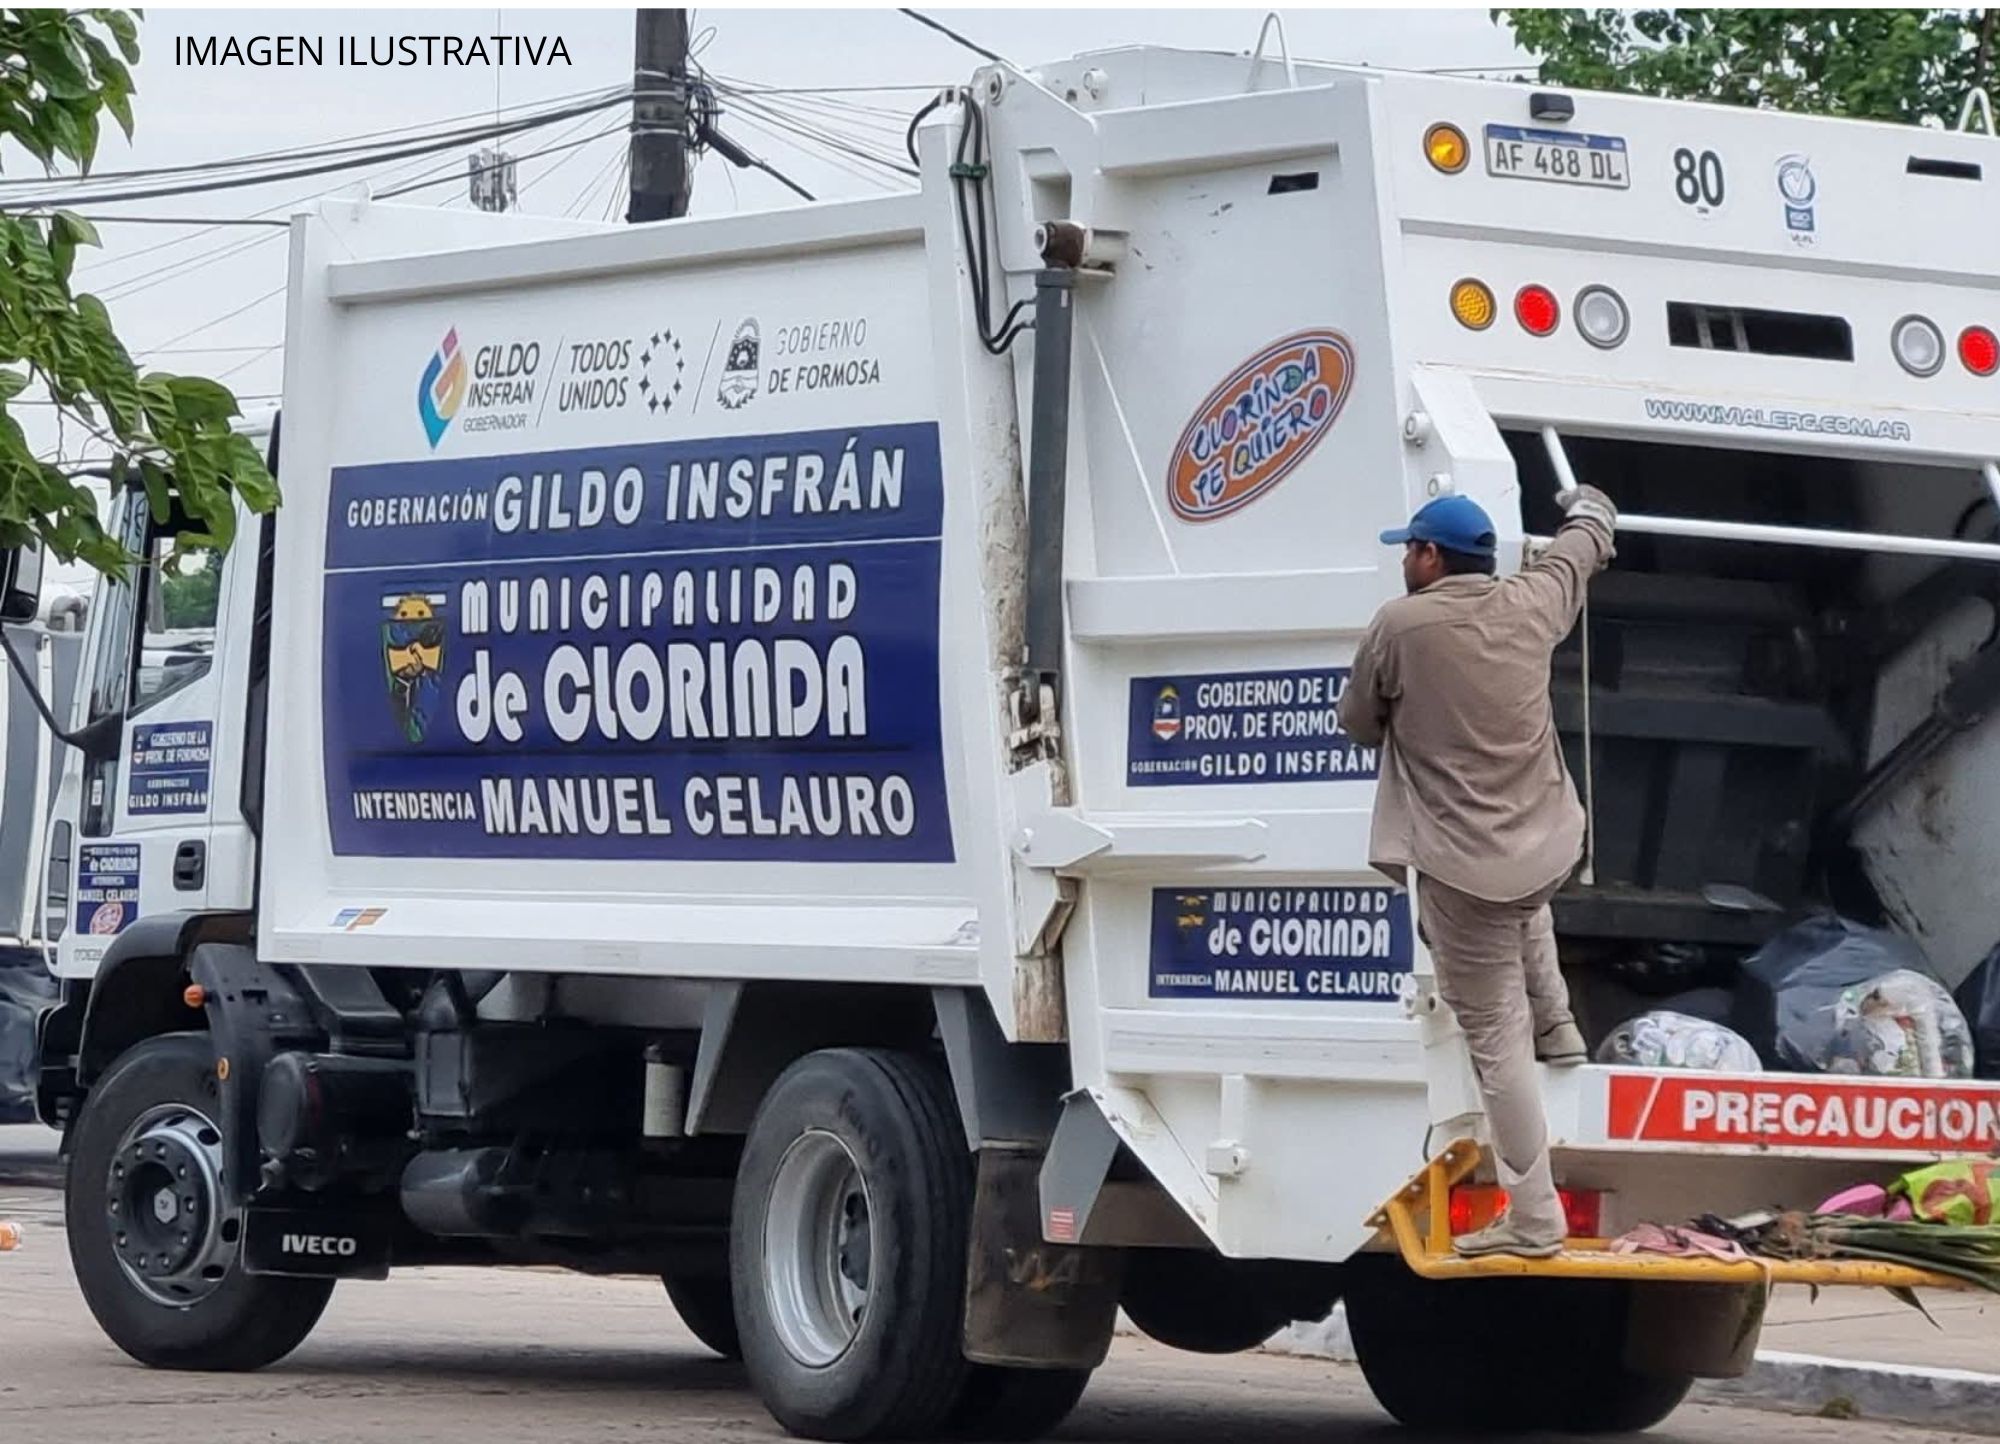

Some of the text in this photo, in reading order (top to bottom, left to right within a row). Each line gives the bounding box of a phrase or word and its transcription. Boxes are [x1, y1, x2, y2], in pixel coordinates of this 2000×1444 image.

[1496, 142, 1622, 181] AF 488 DL
[1674, 148, 1724, 207] 80
[474, 342, 540, 379] GILDO
[571, 339, 632, 375] TODOS
[467, 380, 535, 408] INSFRAN
[559, 376, 629, 412] UNIDOS
[768, 358, 880, 394] DE FORMOSA
[463, 413, 527, 432] GOBERNADOR
[1232, 387, 1328, 477] QUIERO
[347, 437, 907, 534] GOBERNACIÓN GILDO INSFRÁN
[461, 564, 857, 635] MUNICIPALIDAD
[456, 635, 869, 744] de CLORINDA
[1197, 680, 1293, 708] GOBIERNO
[1298, 677, 1322, 704] DE
[1184, 709, 1347, 740] PROV. DE FORMO
[1200, 753, 1267, 777] GILDO
[1276, 744, 1376, 774] INSFRÁN
[129, 789, 207, 808] GILDO INSFRÁN
[353, 774, 916, 837] INTENDENCIA MANUEL CELAURO
[1213, 891, 1389, 913] MUNICIPALIDAD
[1208, 918, 1391, 958] de CLORINDA
[1156, 972, 1213, 986] INTENDENCIA
[1215, 969, 1300, 993] MANUEL
[1682, 1089, 2000, 1142] PRECAUCION
[282, 1234, 356, 1256] IVECO
